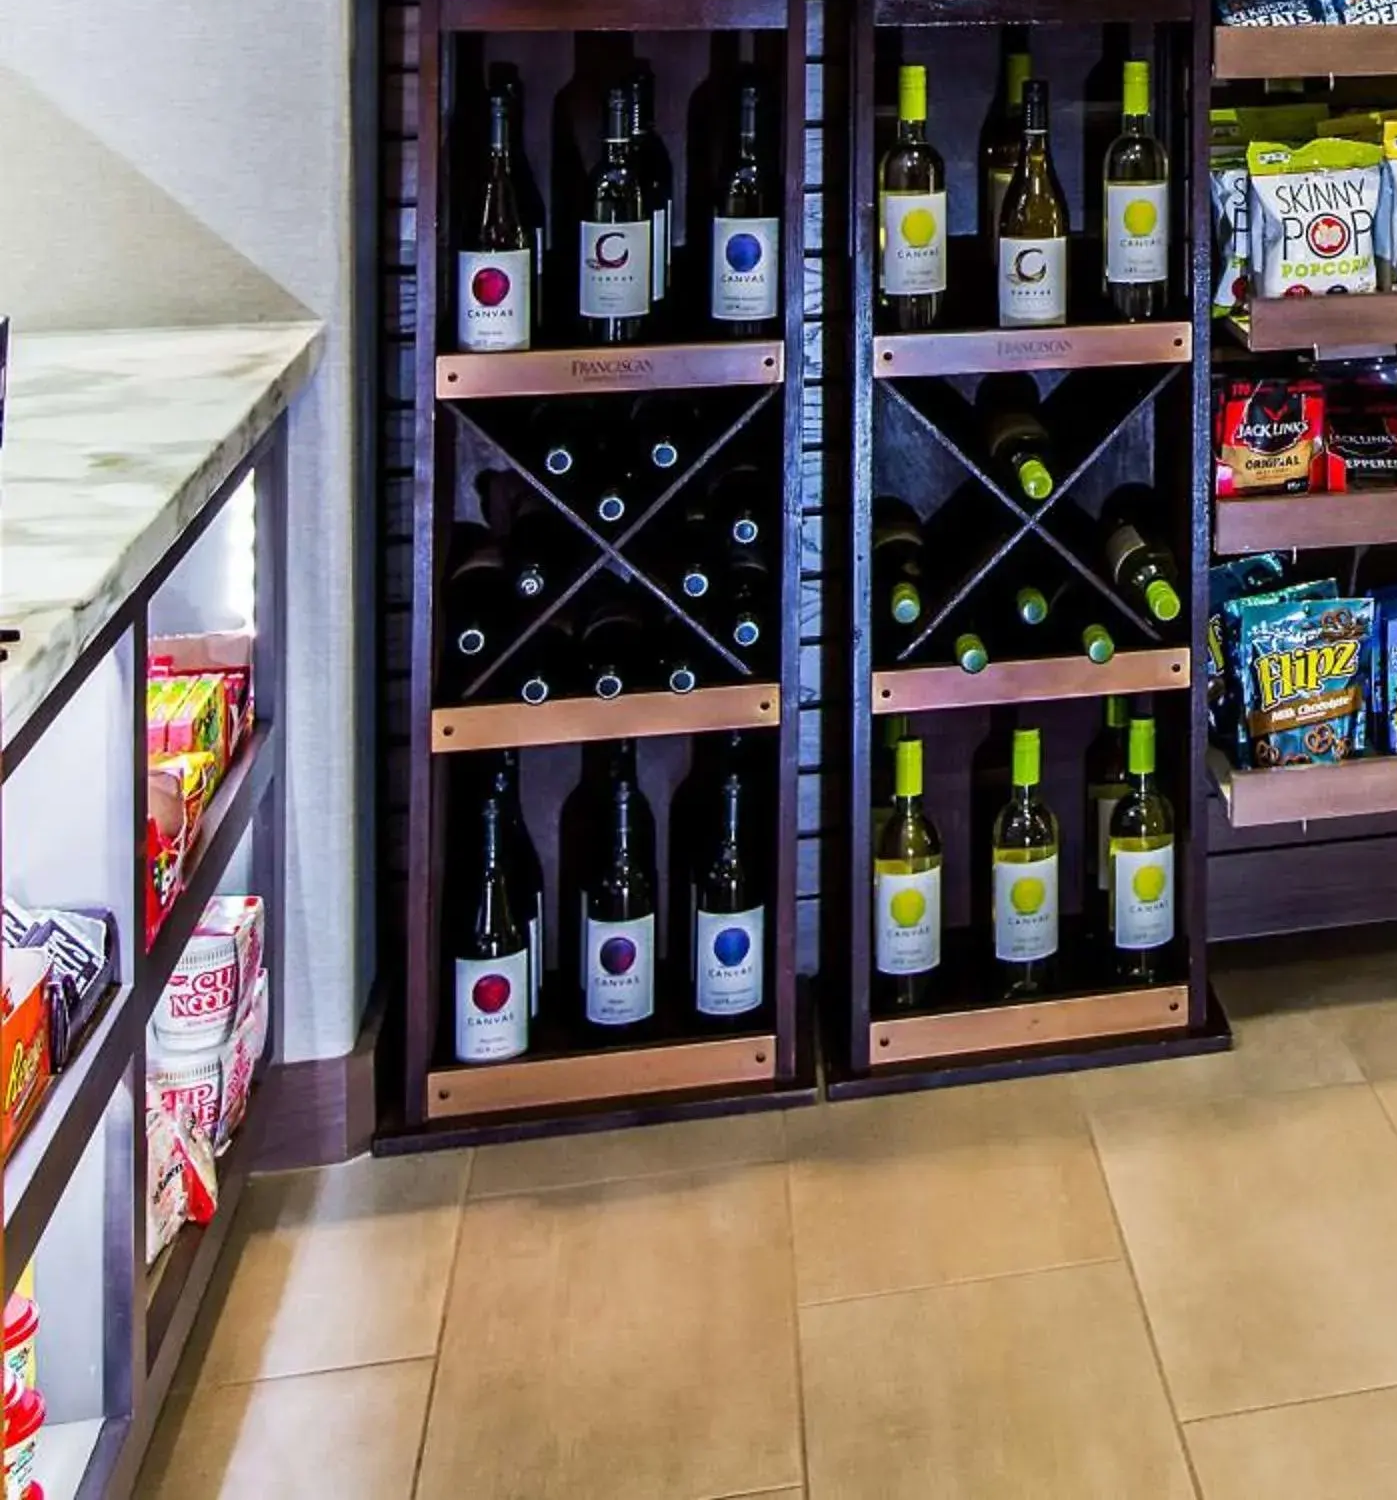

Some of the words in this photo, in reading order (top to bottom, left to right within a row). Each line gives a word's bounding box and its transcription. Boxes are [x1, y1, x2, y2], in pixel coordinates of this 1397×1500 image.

[1231, 9, 1313, 26] REATS
[1275, 178, 1365, 215] SKINNY
[1282, 208, 1375, 260] POP
[1280, 259, 1373, 279] POPCORN
[720, 275, 766, 284] CANVAS
[467, 309, 515, 319] CANVAS
[1245, 455, 1300, 471] ORIGINAL
[1254, 640, 1361, 713] Flipz
[191, 964, 237, 994] CU
